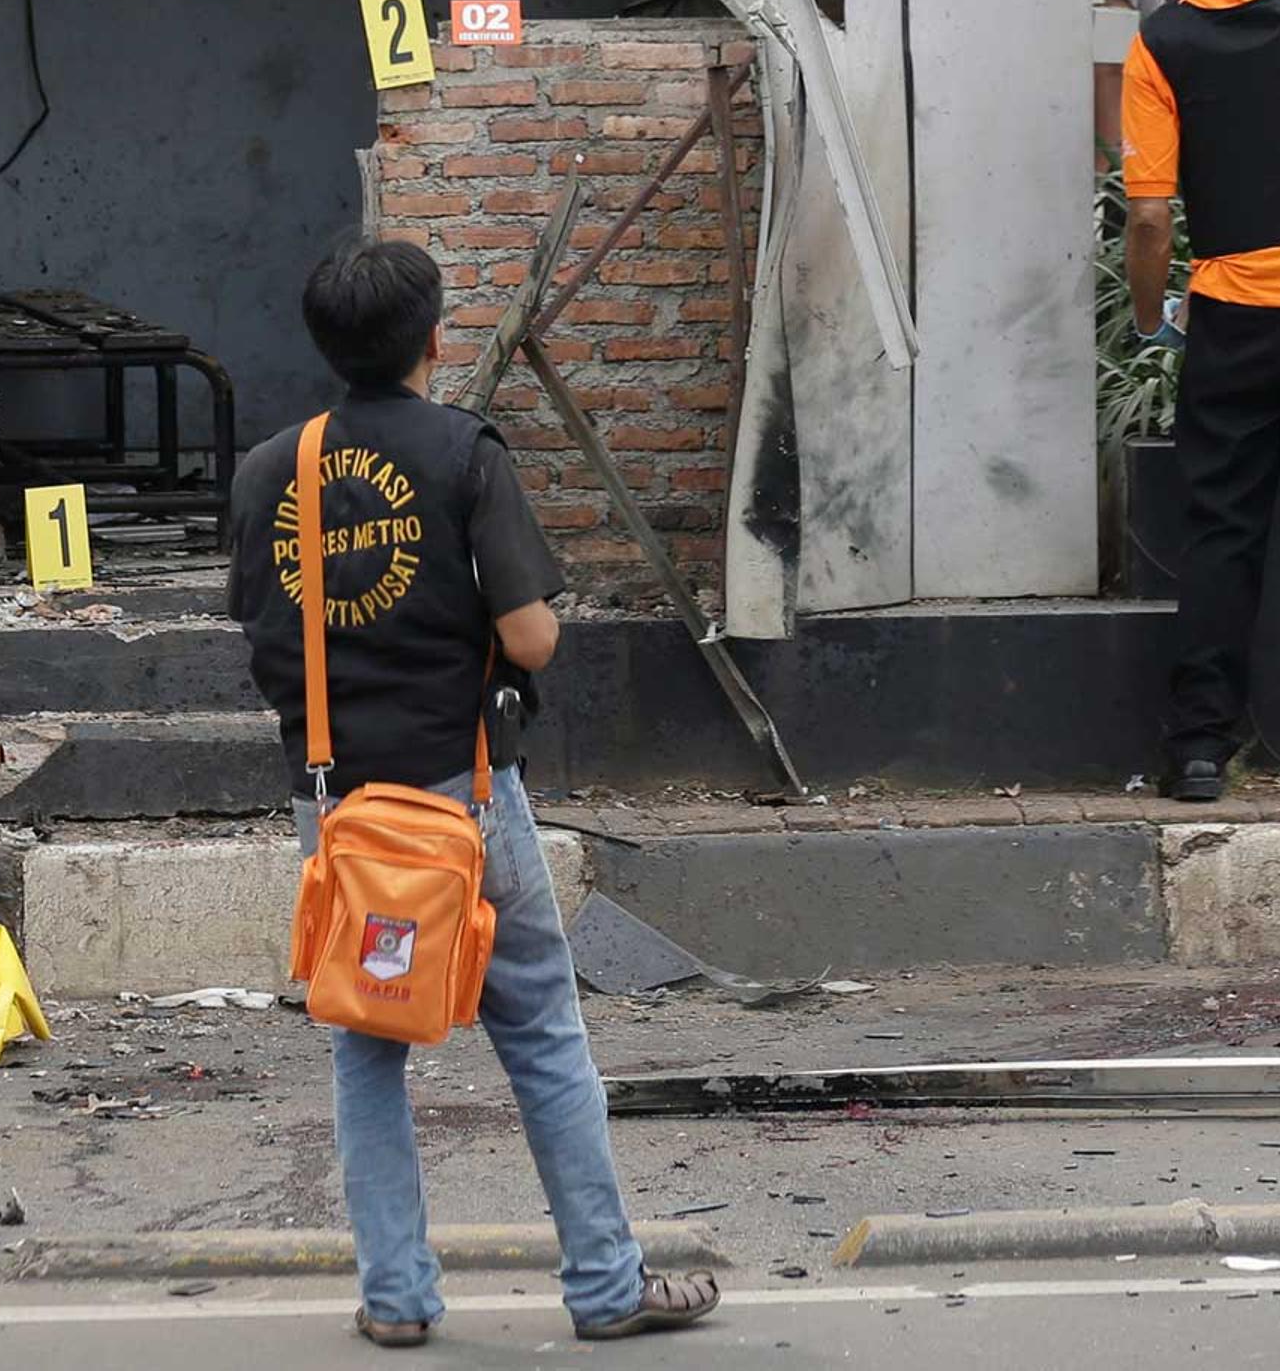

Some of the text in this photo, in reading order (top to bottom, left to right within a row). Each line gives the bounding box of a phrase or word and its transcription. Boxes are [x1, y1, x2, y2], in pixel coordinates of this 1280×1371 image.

[462, 3, 510, 30] 02
[273, 447, 415, 532] IDTIFIKASI
[48, 498, 71, 568] 1
[273, 515, 422, 566] POES METRO
[279, 546, 420, 627] JARTA PUSAT
